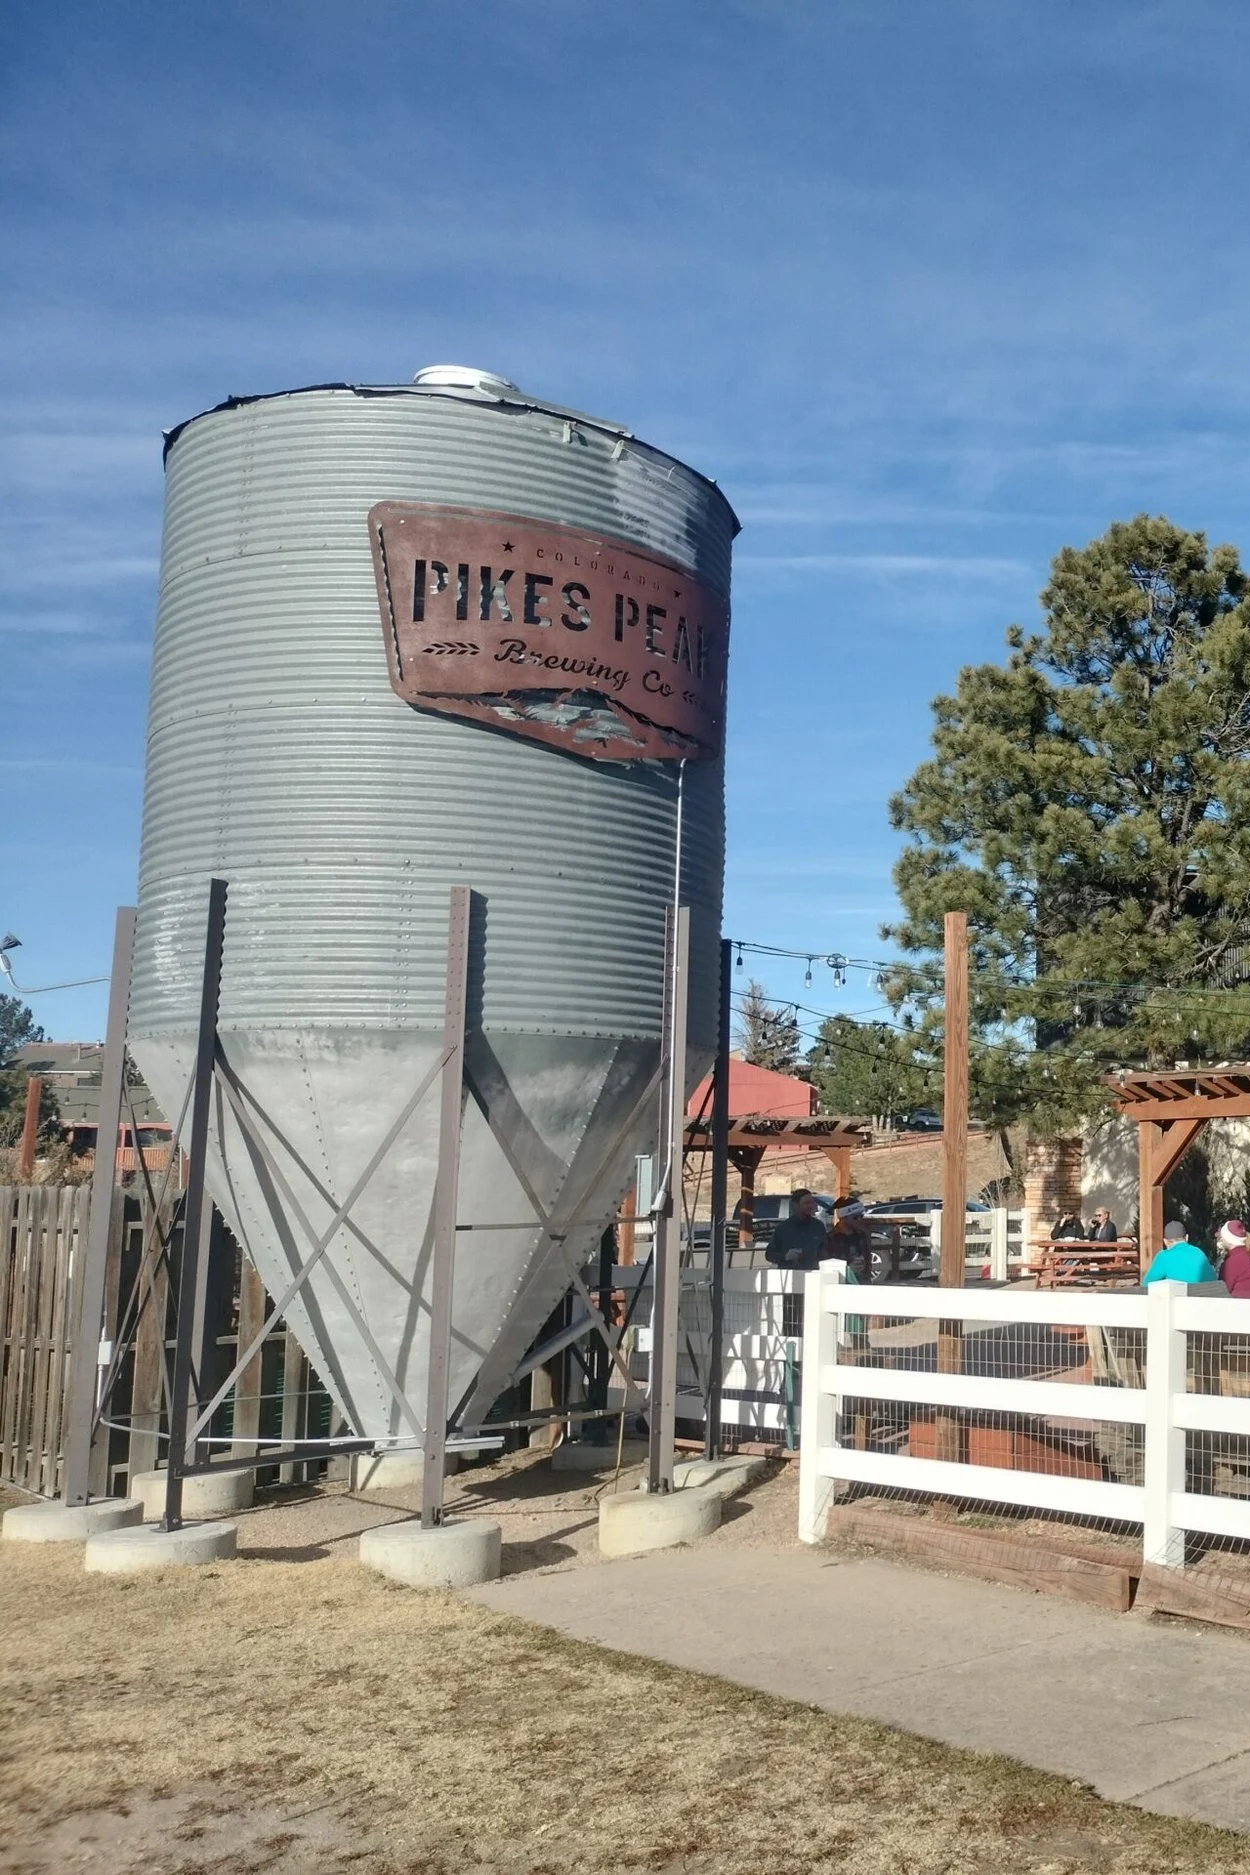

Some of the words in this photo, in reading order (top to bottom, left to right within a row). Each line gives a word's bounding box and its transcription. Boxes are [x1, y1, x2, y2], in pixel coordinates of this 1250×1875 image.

[412, 558, 592, 633] PIKES
[536, 548, 661, 592] COLORADO
[493, 637, 631, 692] Brewing
[641, 669, 675, 697] Co
